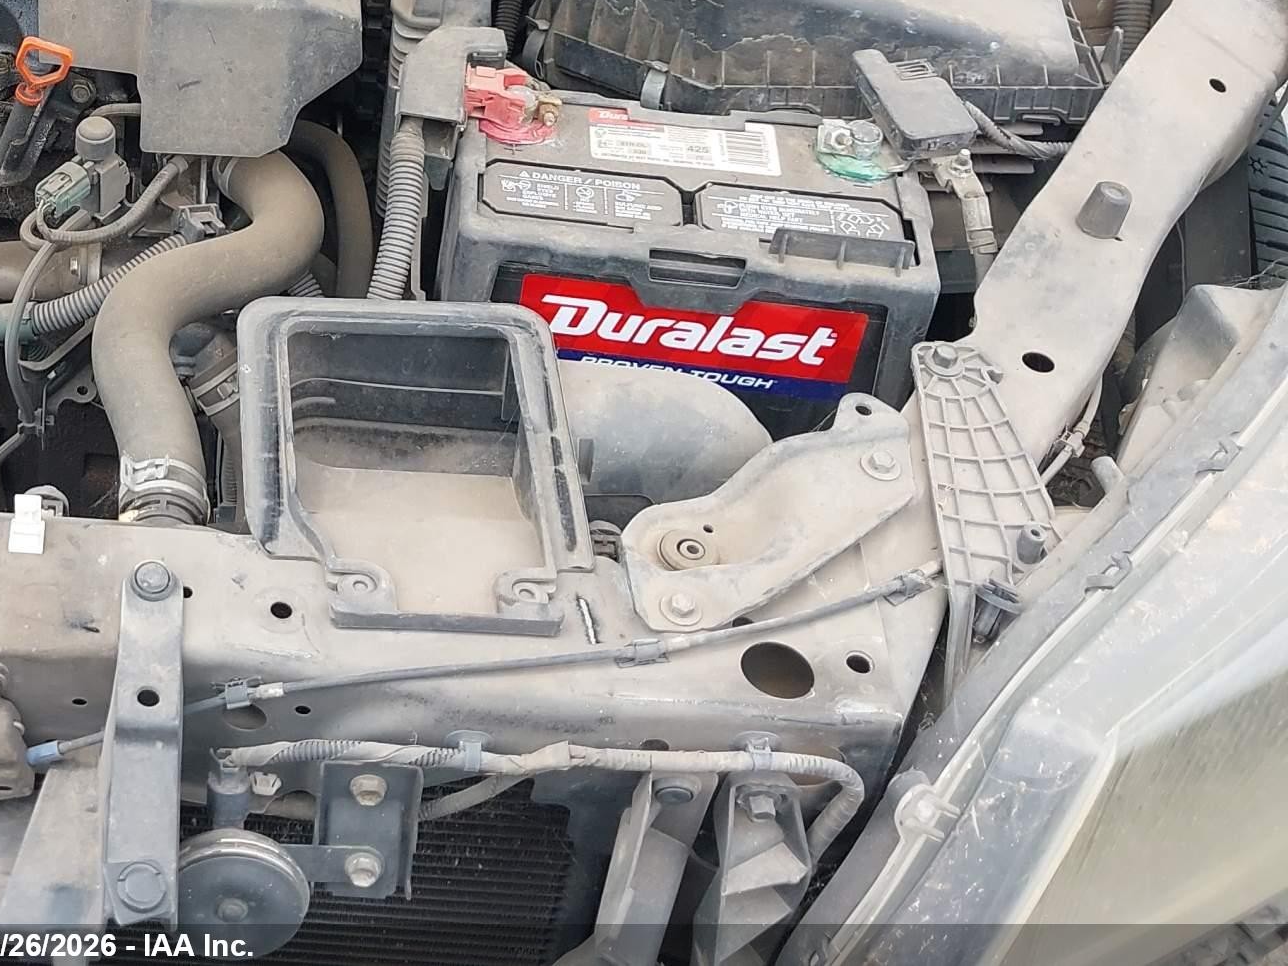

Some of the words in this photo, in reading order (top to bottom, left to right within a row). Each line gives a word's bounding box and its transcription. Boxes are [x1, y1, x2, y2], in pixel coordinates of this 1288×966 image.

[532, 171, 583, 184] DANGER
[594, 178, 641, 190] POISON
[542, 294, 835, 365] Duralast
[690, 369, 774, 389] TOUGH
